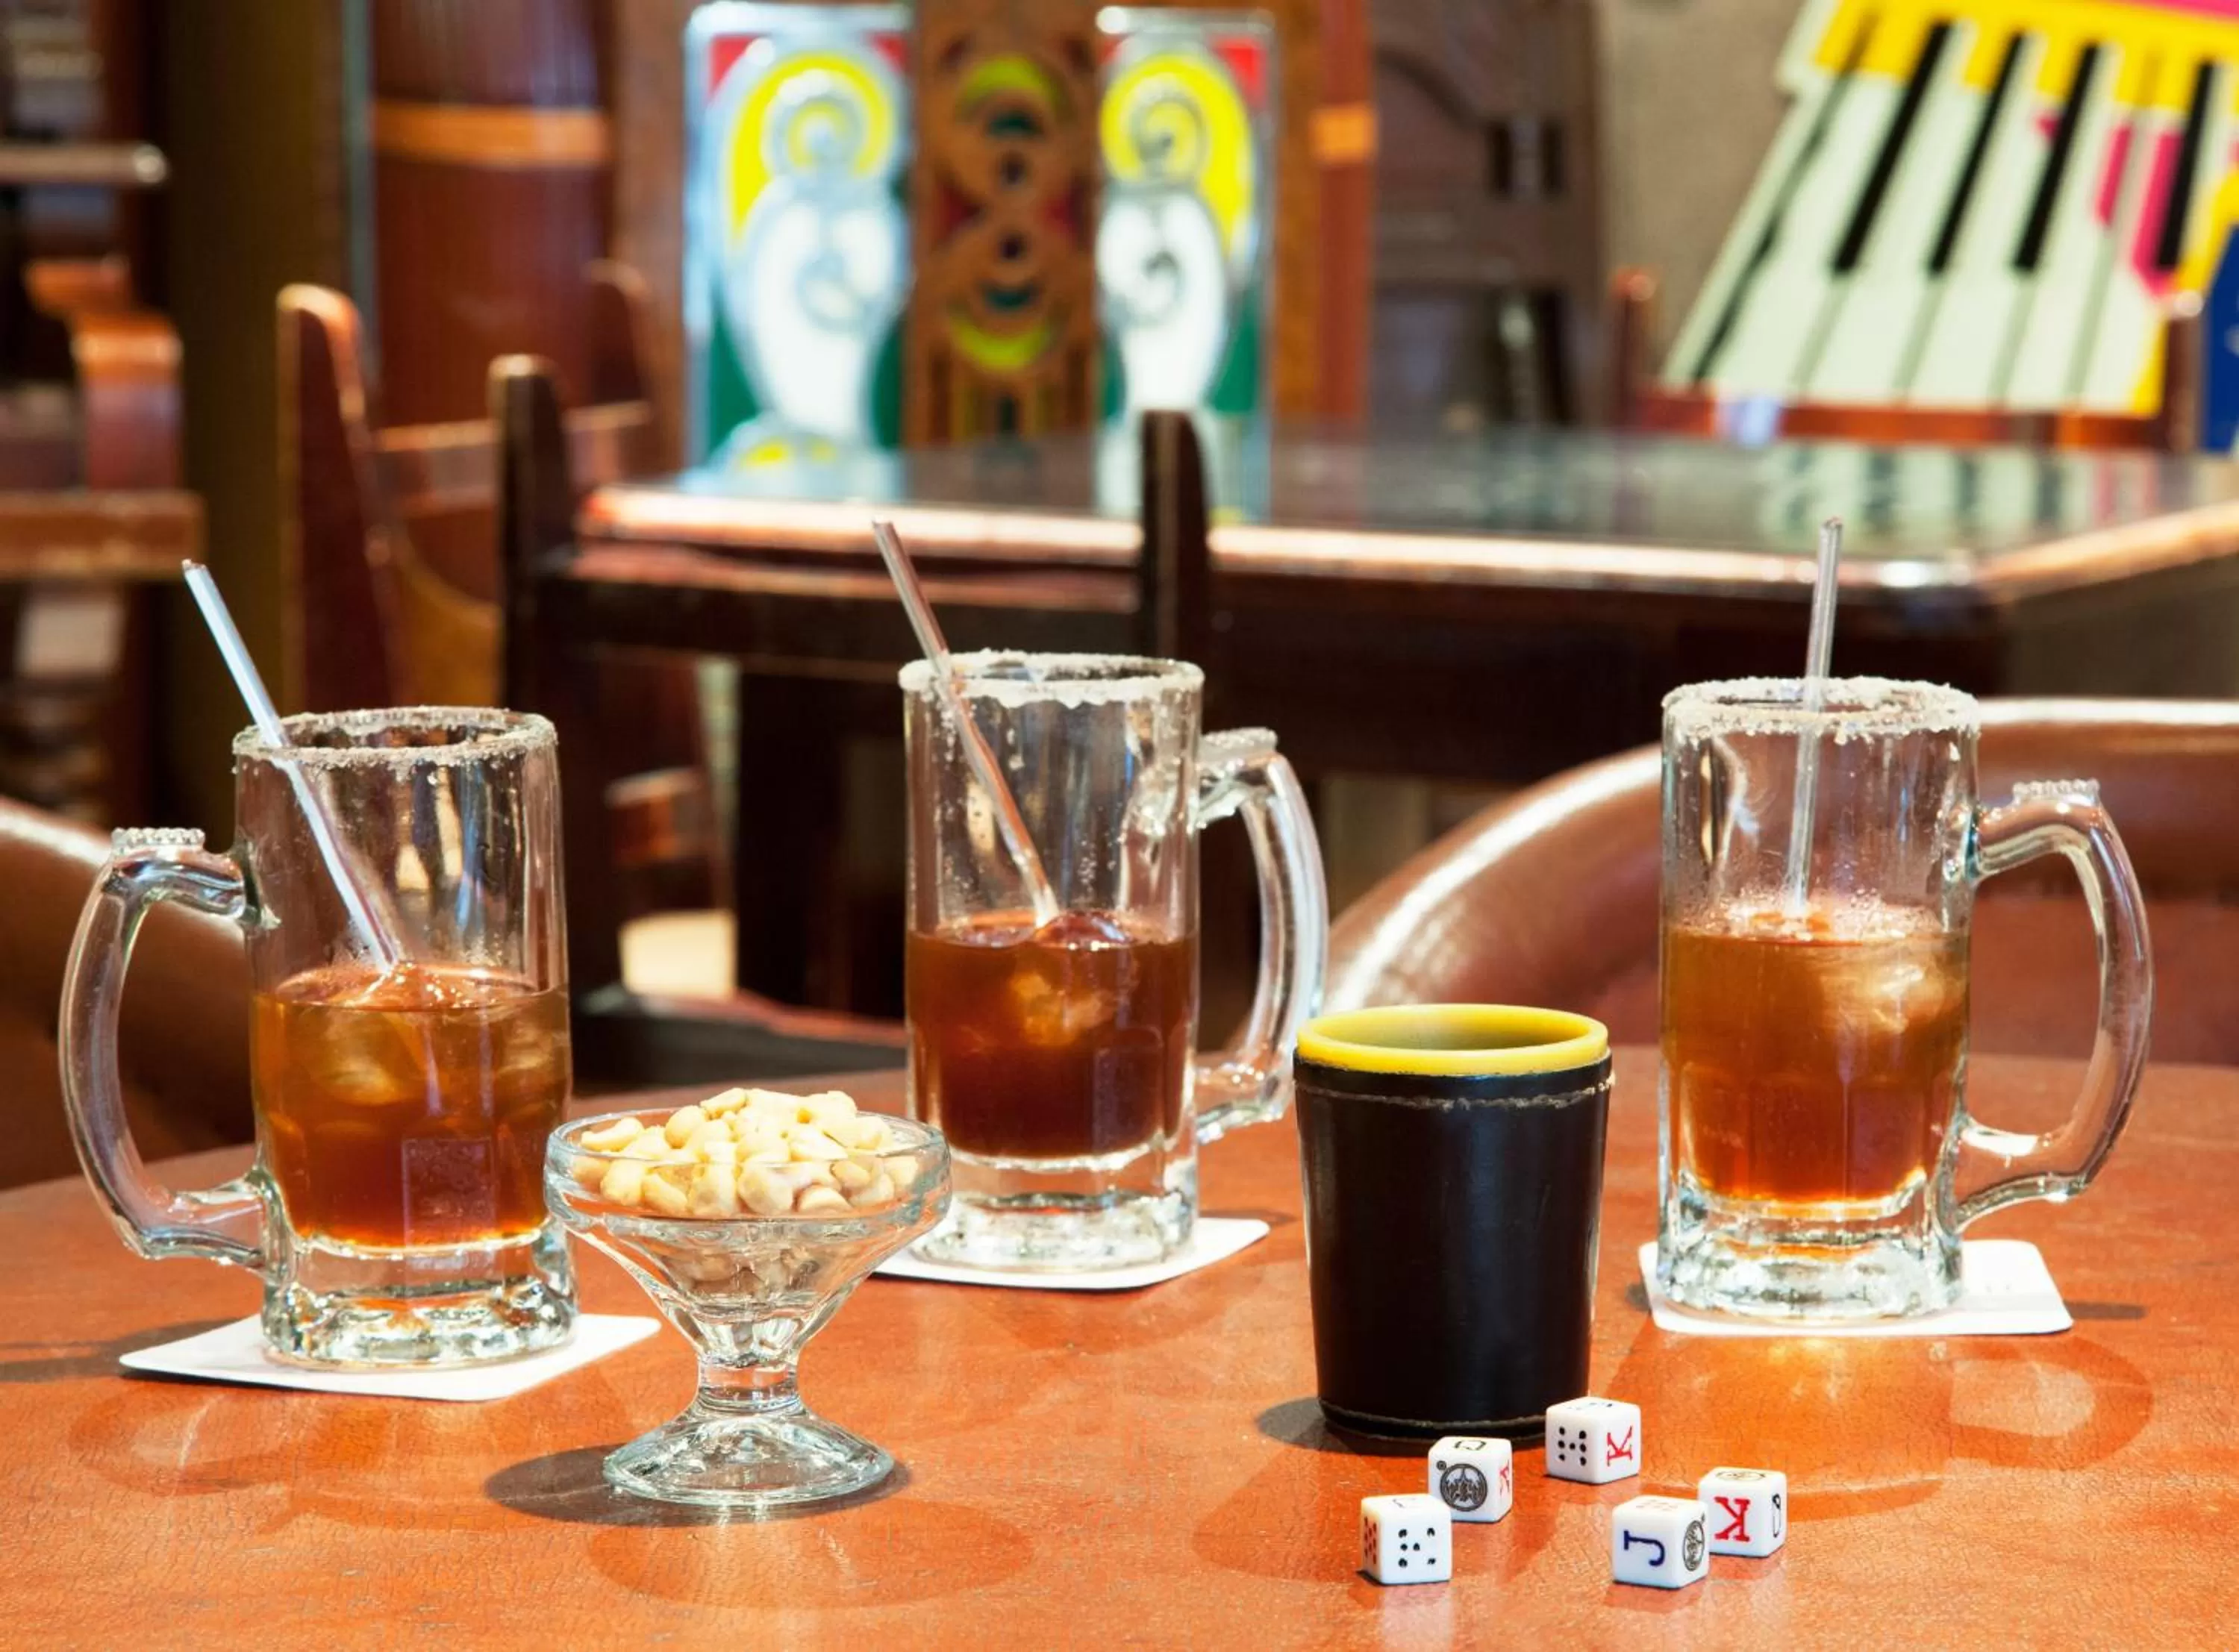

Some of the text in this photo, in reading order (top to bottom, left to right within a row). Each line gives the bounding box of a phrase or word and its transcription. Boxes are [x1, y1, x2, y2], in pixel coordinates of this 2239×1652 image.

[1606, 1424, 1633, 1467] K
[1714, 1496, 1750, 1542] K
[1623, 1530, 1666, 1568] J
